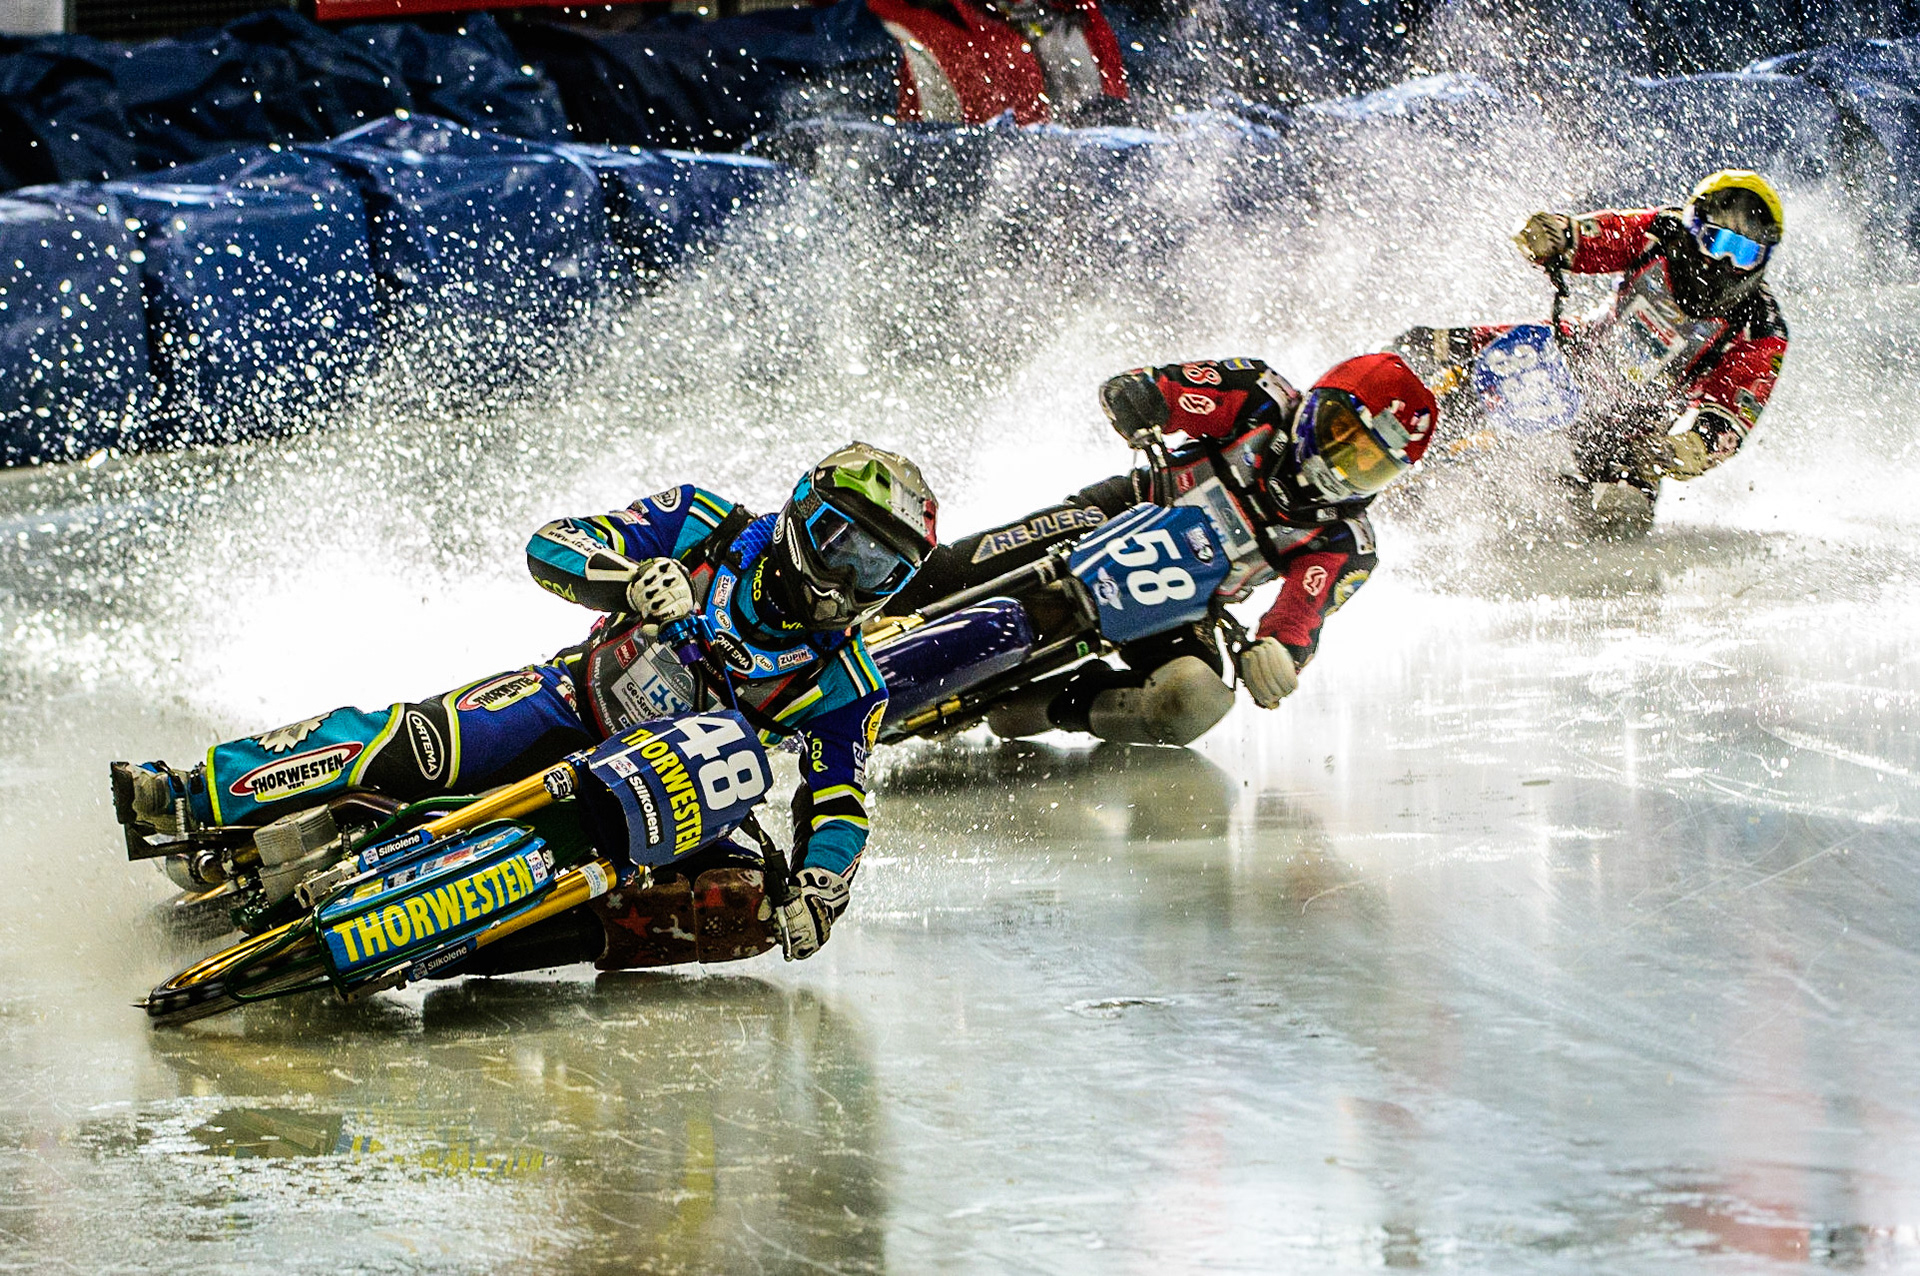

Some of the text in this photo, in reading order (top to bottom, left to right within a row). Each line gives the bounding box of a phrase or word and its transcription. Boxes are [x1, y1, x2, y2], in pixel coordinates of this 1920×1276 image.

[990, 507, 1105, 552] REJLERS
[1105, 528, 1196, 605] 58
[780, 650, 809, 665] ZUPIN
[251, 753, 344, 795] THORWESTEN
[411, 715, 438, 774] ORTEMA
[673, 716, 765, 810] 48
[620, 728, 702, 856] THORWESTEN
[628, 775, 660, 845] Silkolene
[378, 834, 421, 857] Silkolene
[332, 854, 535, 962] THORWESTEN
[427, 945, 467, 971] Silkolene
